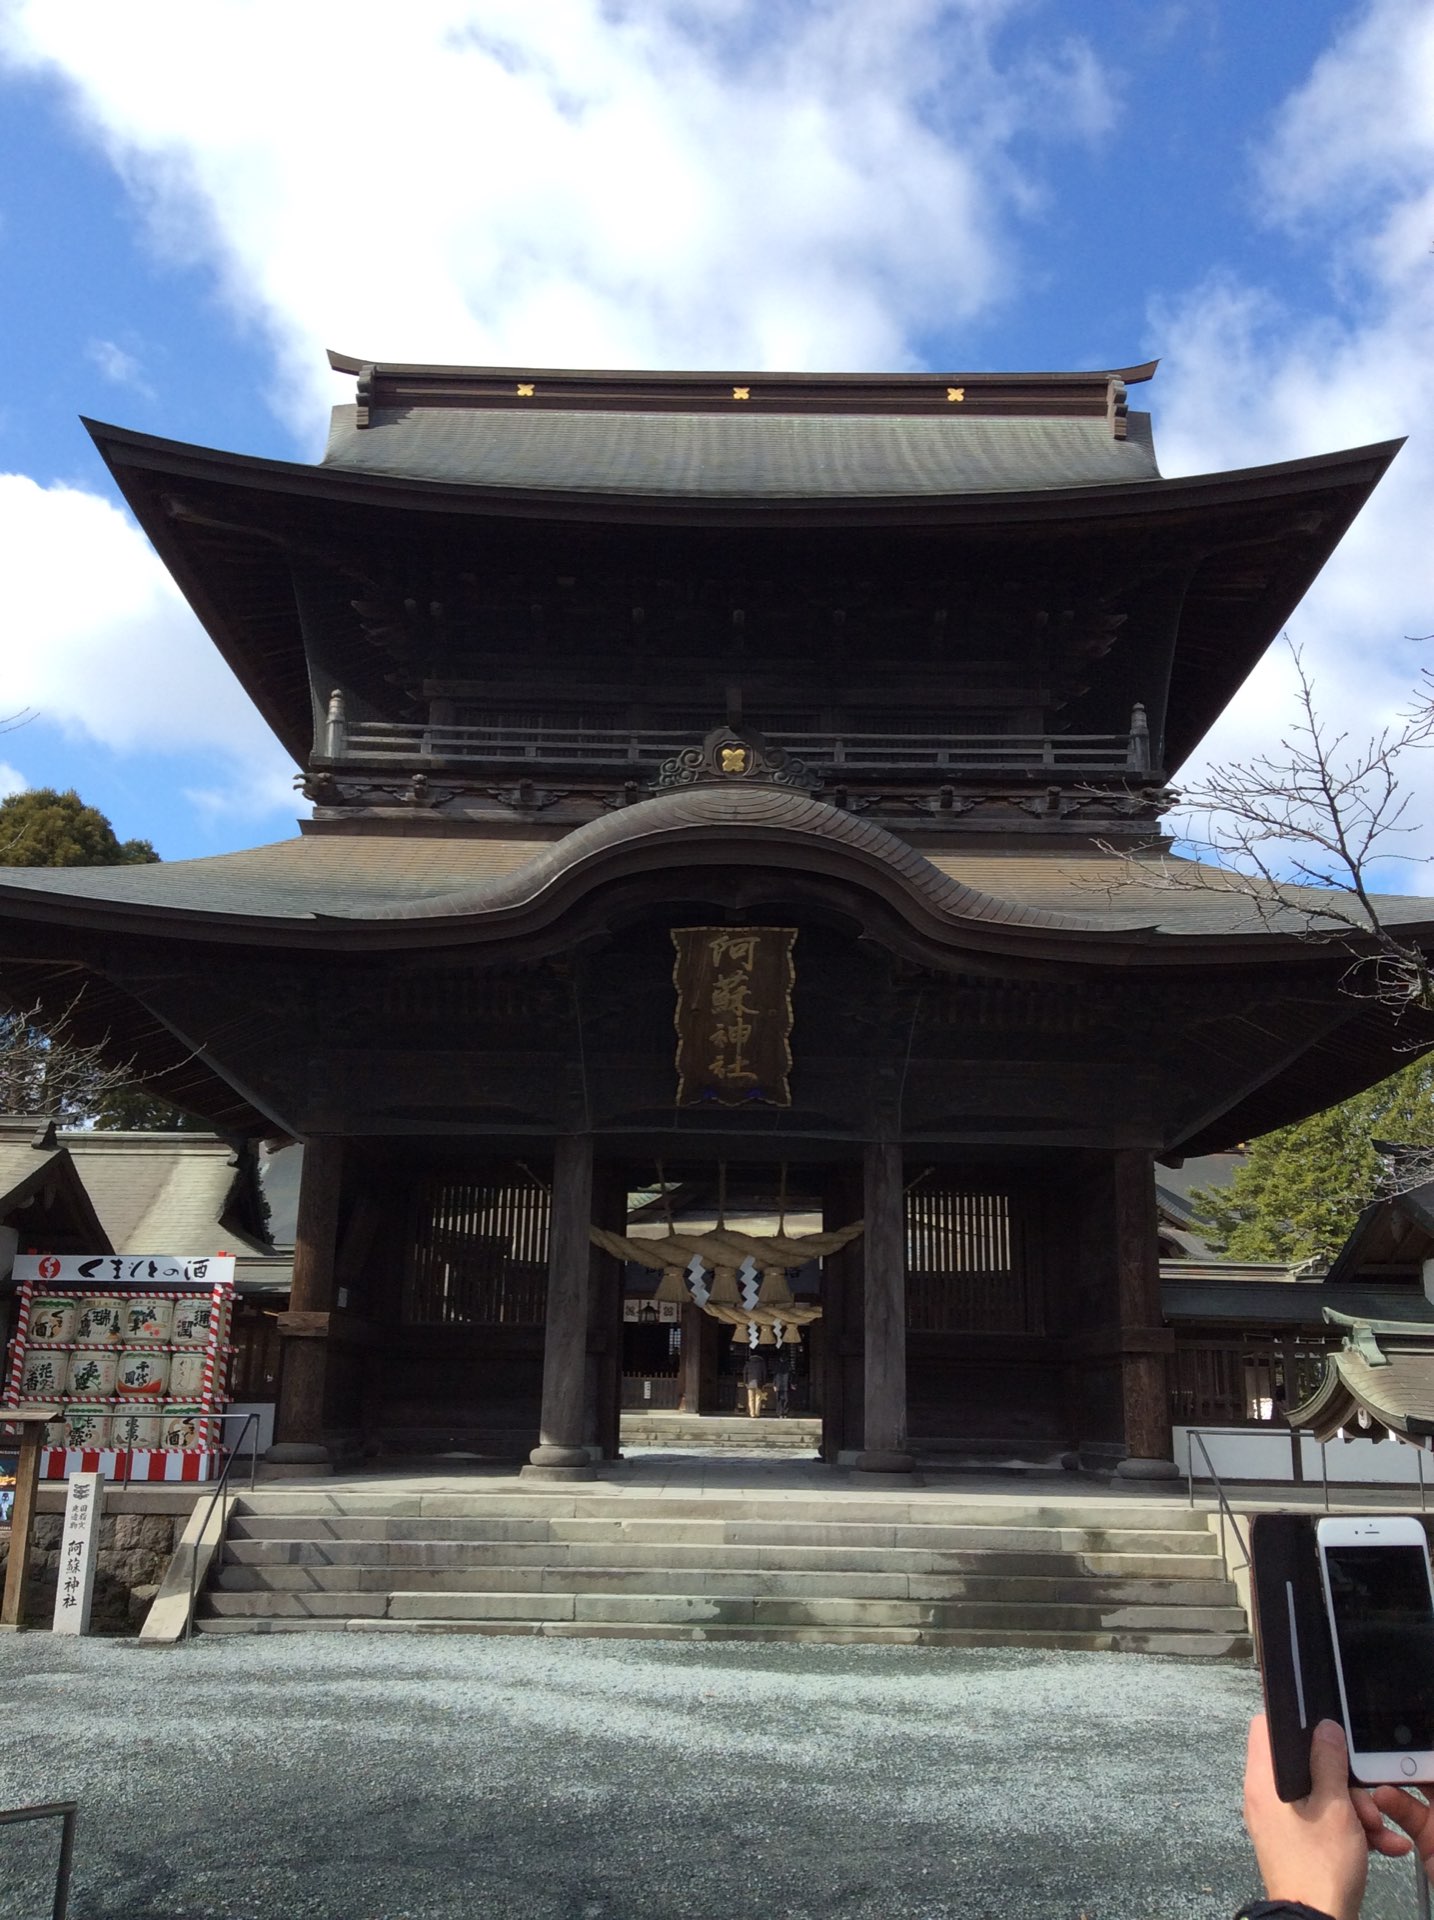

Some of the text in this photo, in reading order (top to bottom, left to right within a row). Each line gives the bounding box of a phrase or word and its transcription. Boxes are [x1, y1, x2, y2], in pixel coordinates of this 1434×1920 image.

[708, 935, 760, 1081] 阿蘇神社
[77, 1258, 210, 1280] くまもとの酒
[62, 1540, 85, 1609] 阿蘇神社
